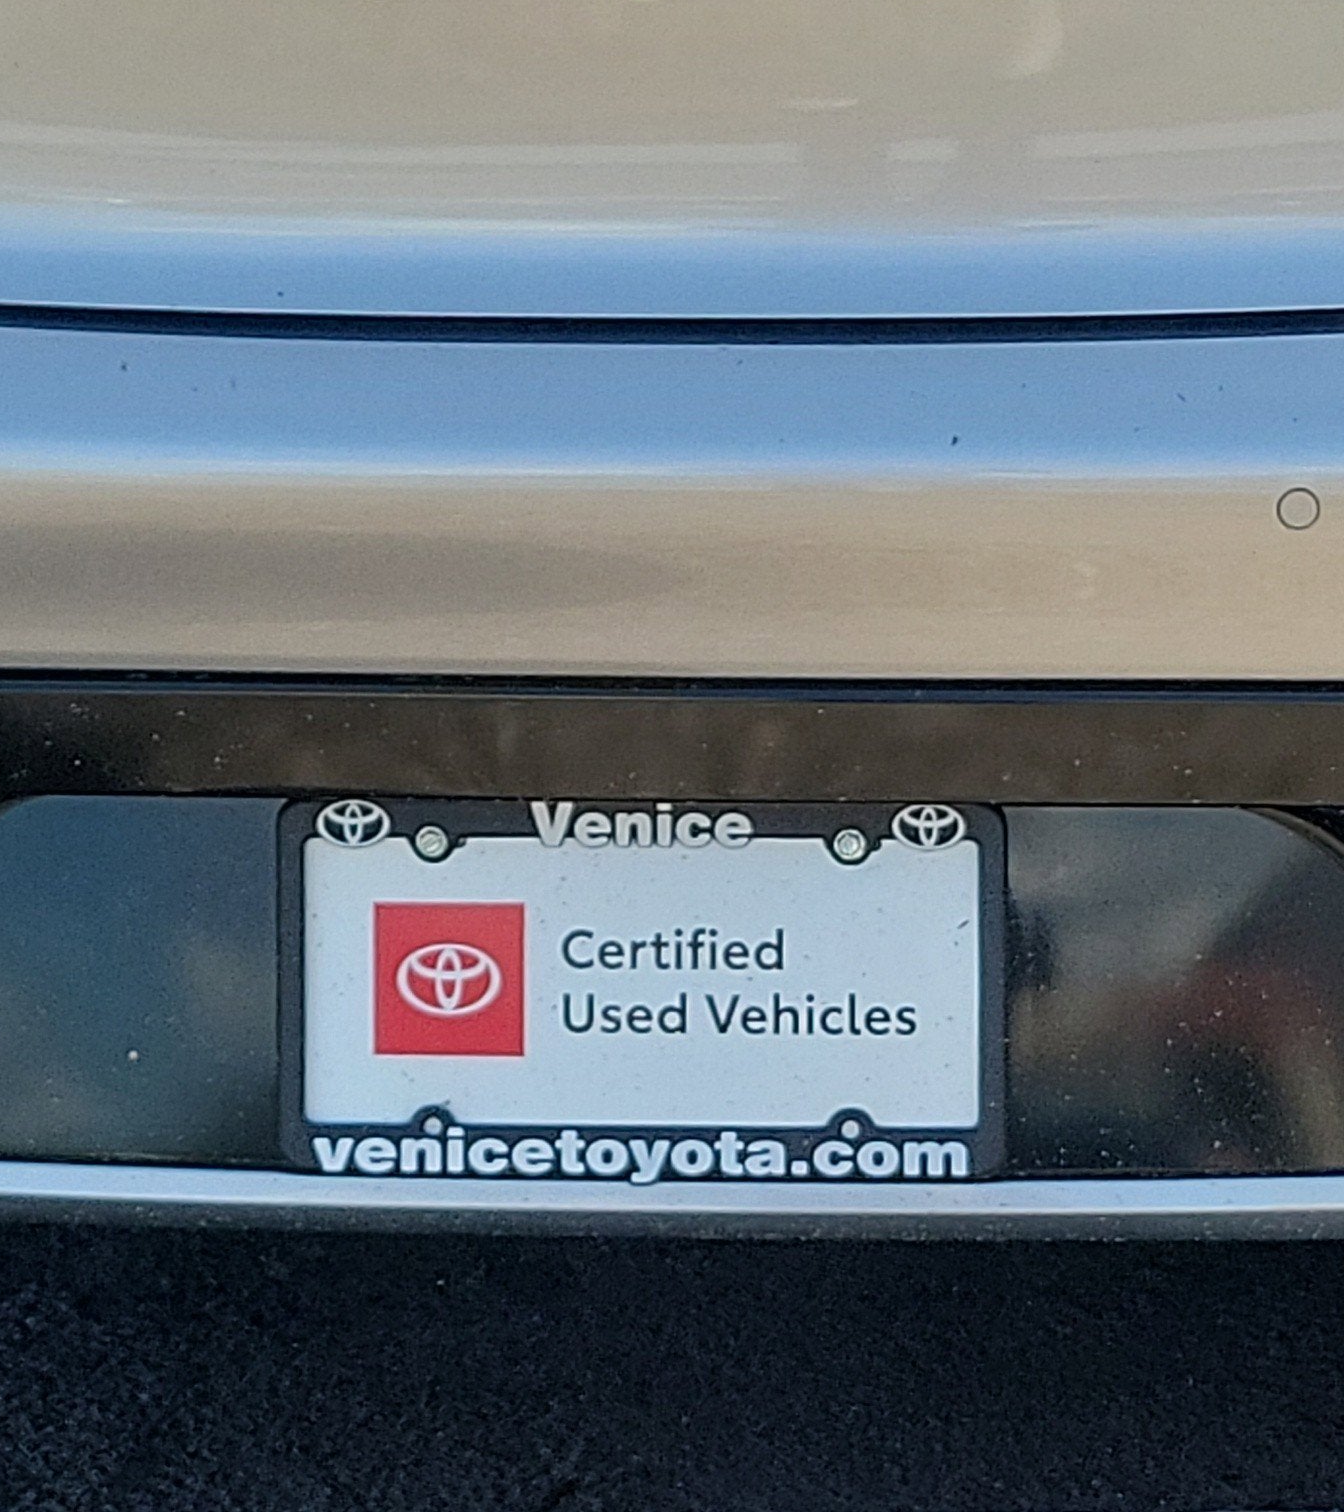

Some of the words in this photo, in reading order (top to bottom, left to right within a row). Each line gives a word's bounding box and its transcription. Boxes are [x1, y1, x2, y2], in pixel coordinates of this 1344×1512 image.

[531, 802, 753, 849] Venice
[561, 929, 786, 971] Certified
[561, 993, 688, 1035] Used
[706, 994, 917, 1036] Vehicles
[312, 1127, 968, 1184] venicetoyota.com
